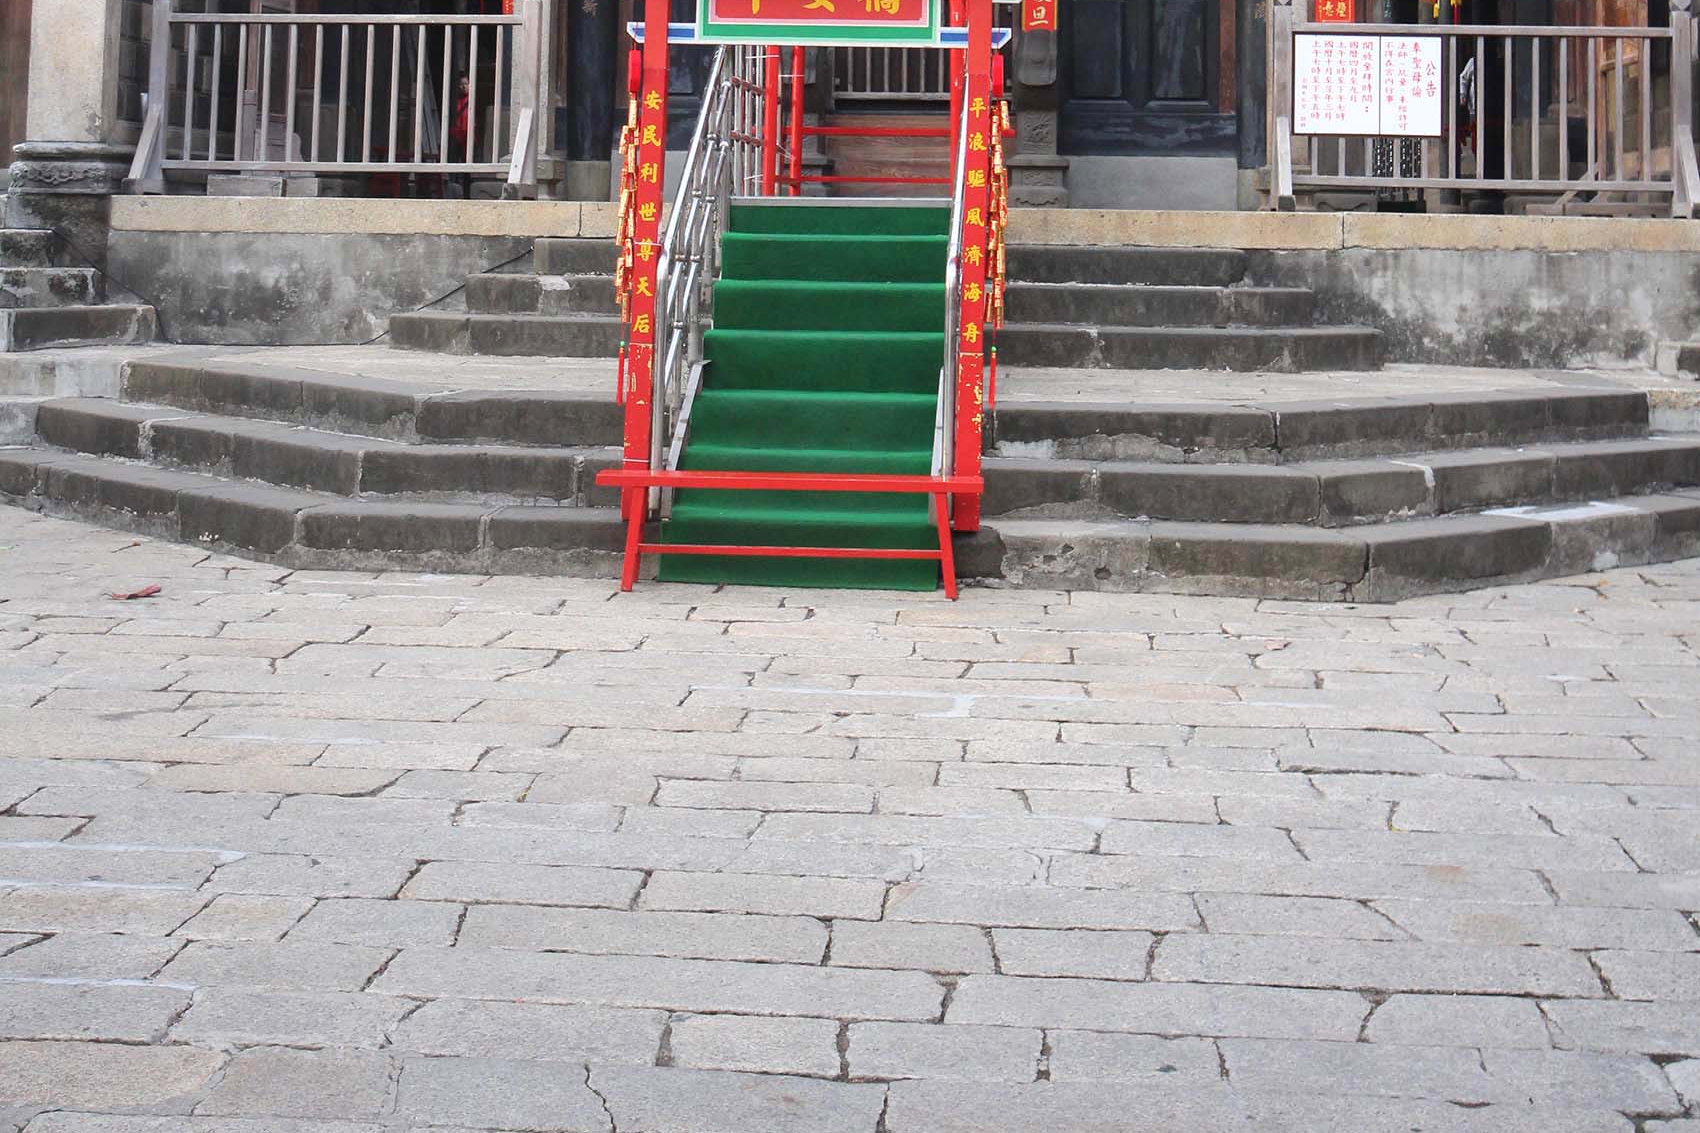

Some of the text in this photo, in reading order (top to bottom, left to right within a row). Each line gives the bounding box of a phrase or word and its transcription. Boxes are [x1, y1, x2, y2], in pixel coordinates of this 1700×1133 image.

[1426, 61, 1437, 98] 公告
[632, 89, 664, 333] 安民利世尊天后
